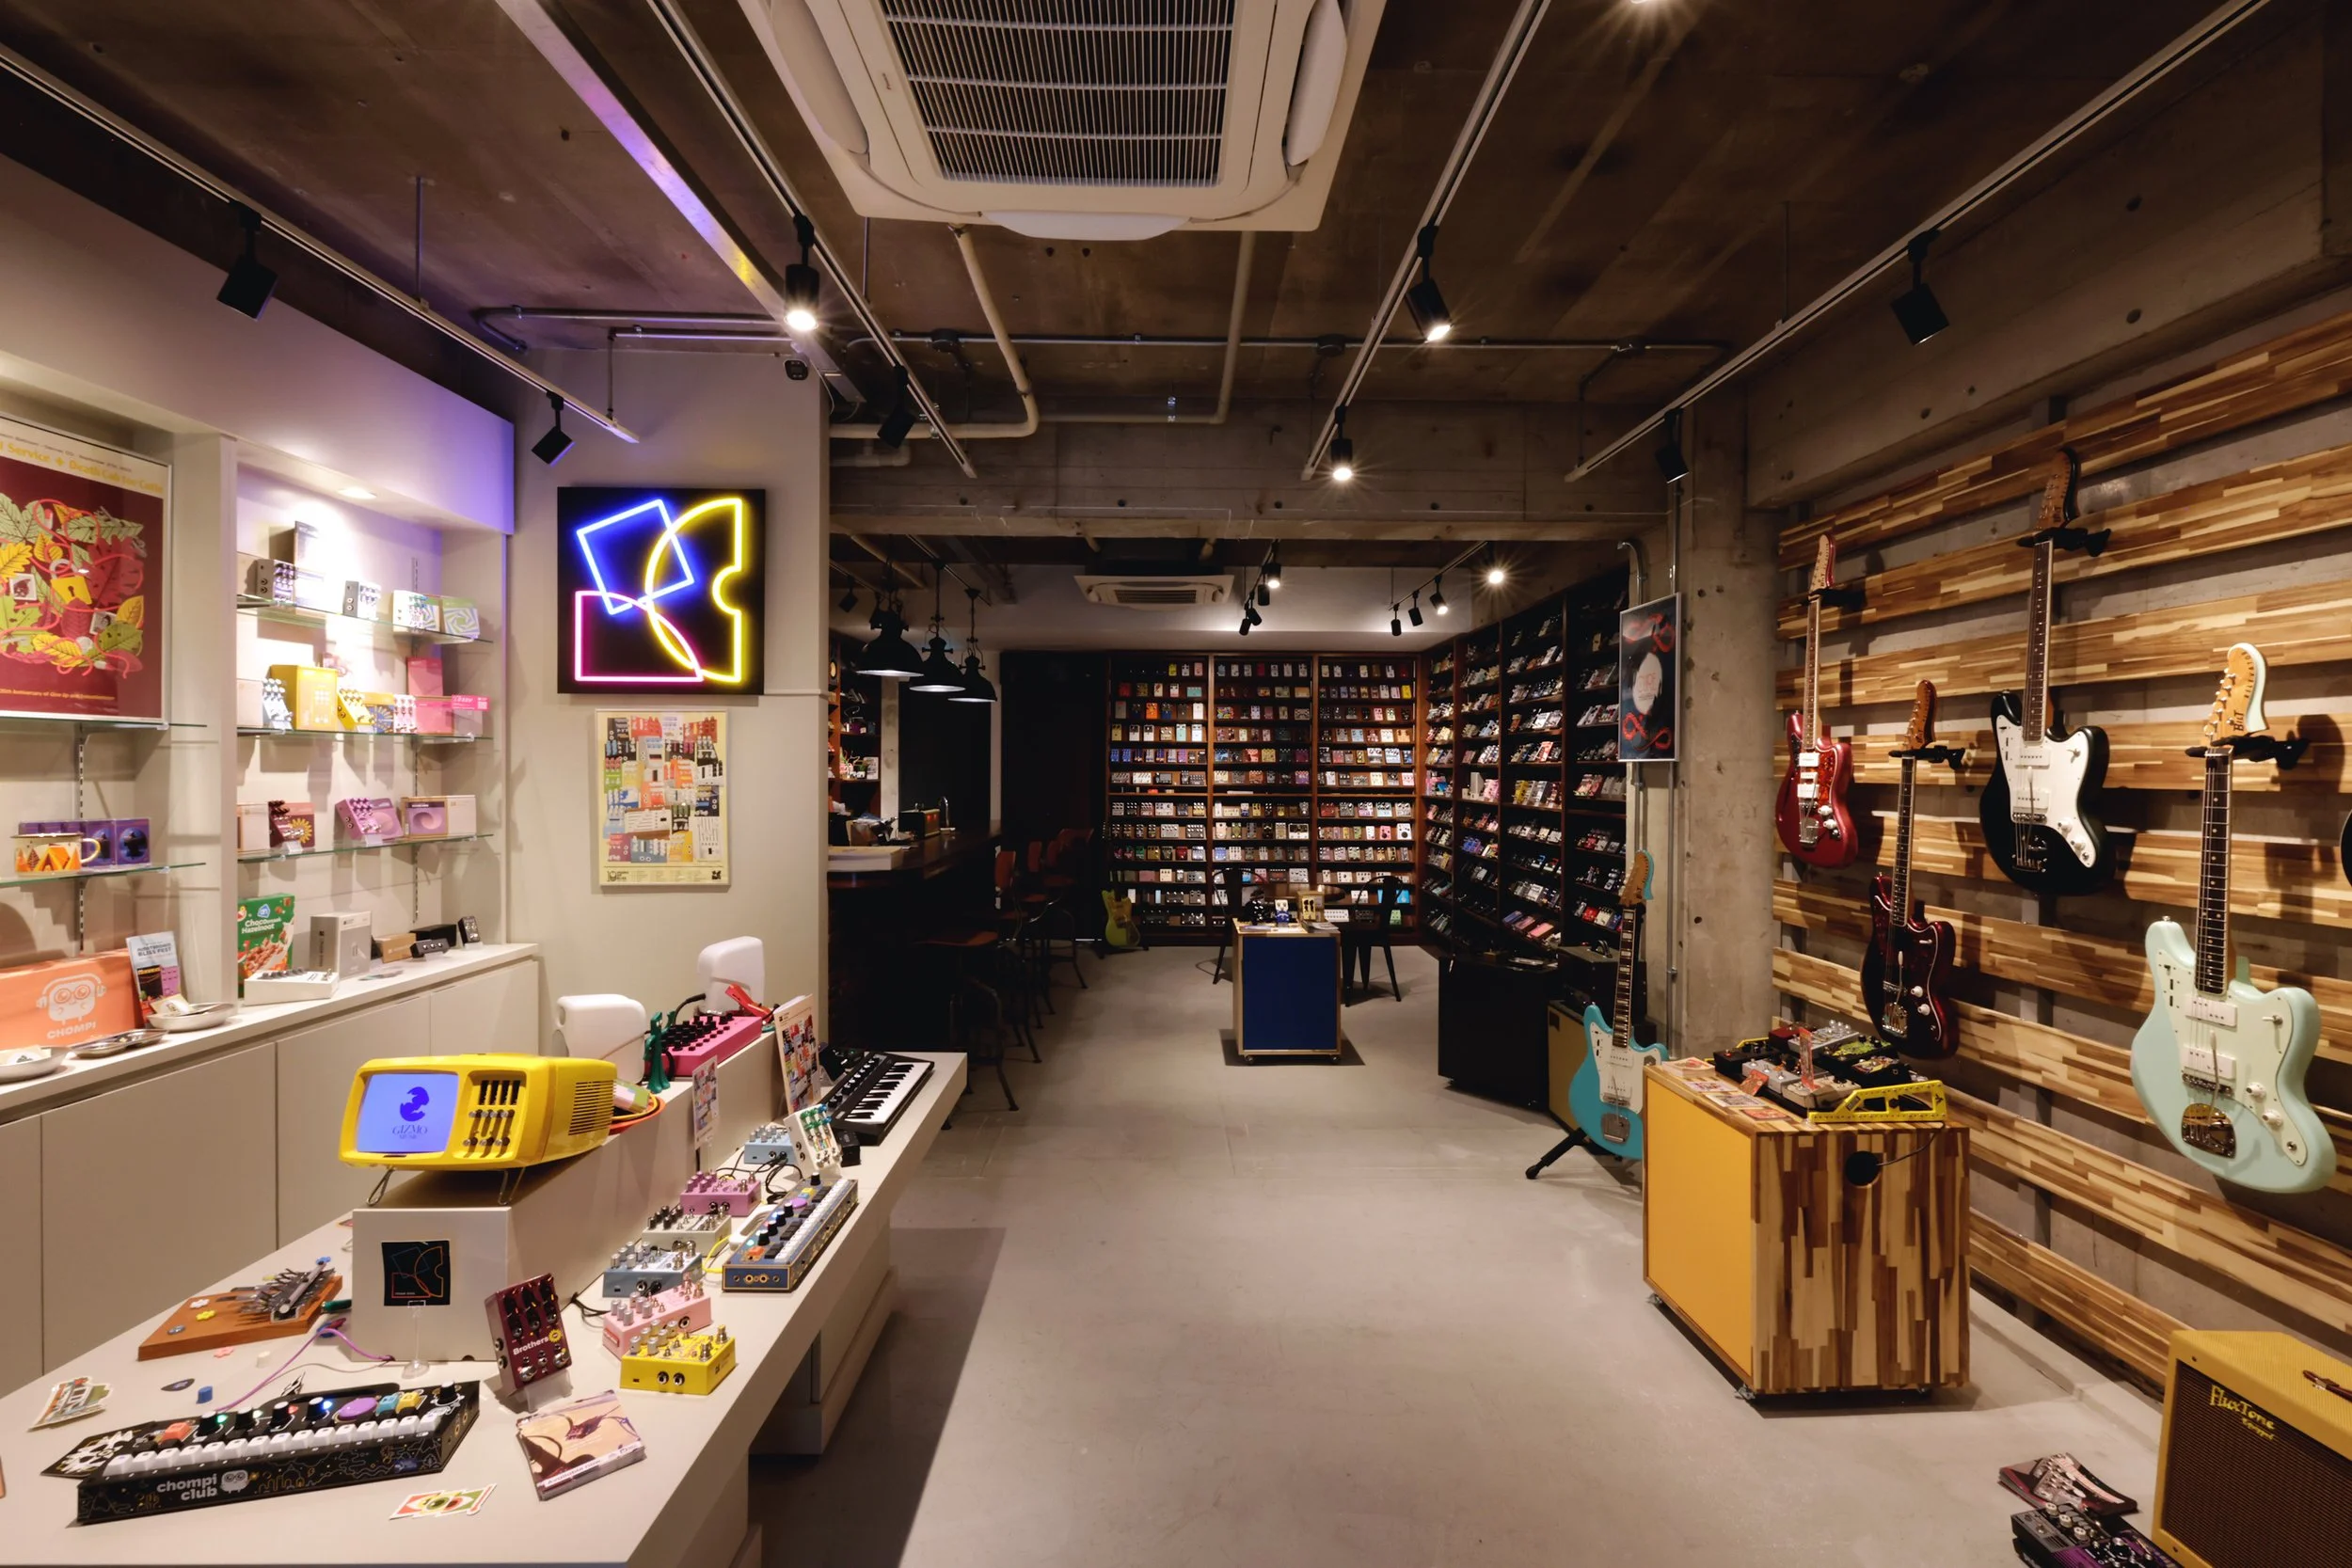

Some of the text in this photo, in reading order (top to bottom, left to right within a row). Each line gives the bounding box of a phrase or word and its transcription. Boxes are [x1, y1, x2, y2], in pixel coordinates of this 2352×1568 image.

[8, 443, 50, 462] Service
[70, 460, 100, 477] Death
[513, 1336, 549, 1355] Brothers
[156, 1473, 217, 1493] chompi
[181, 1486, 218, 1500] club
